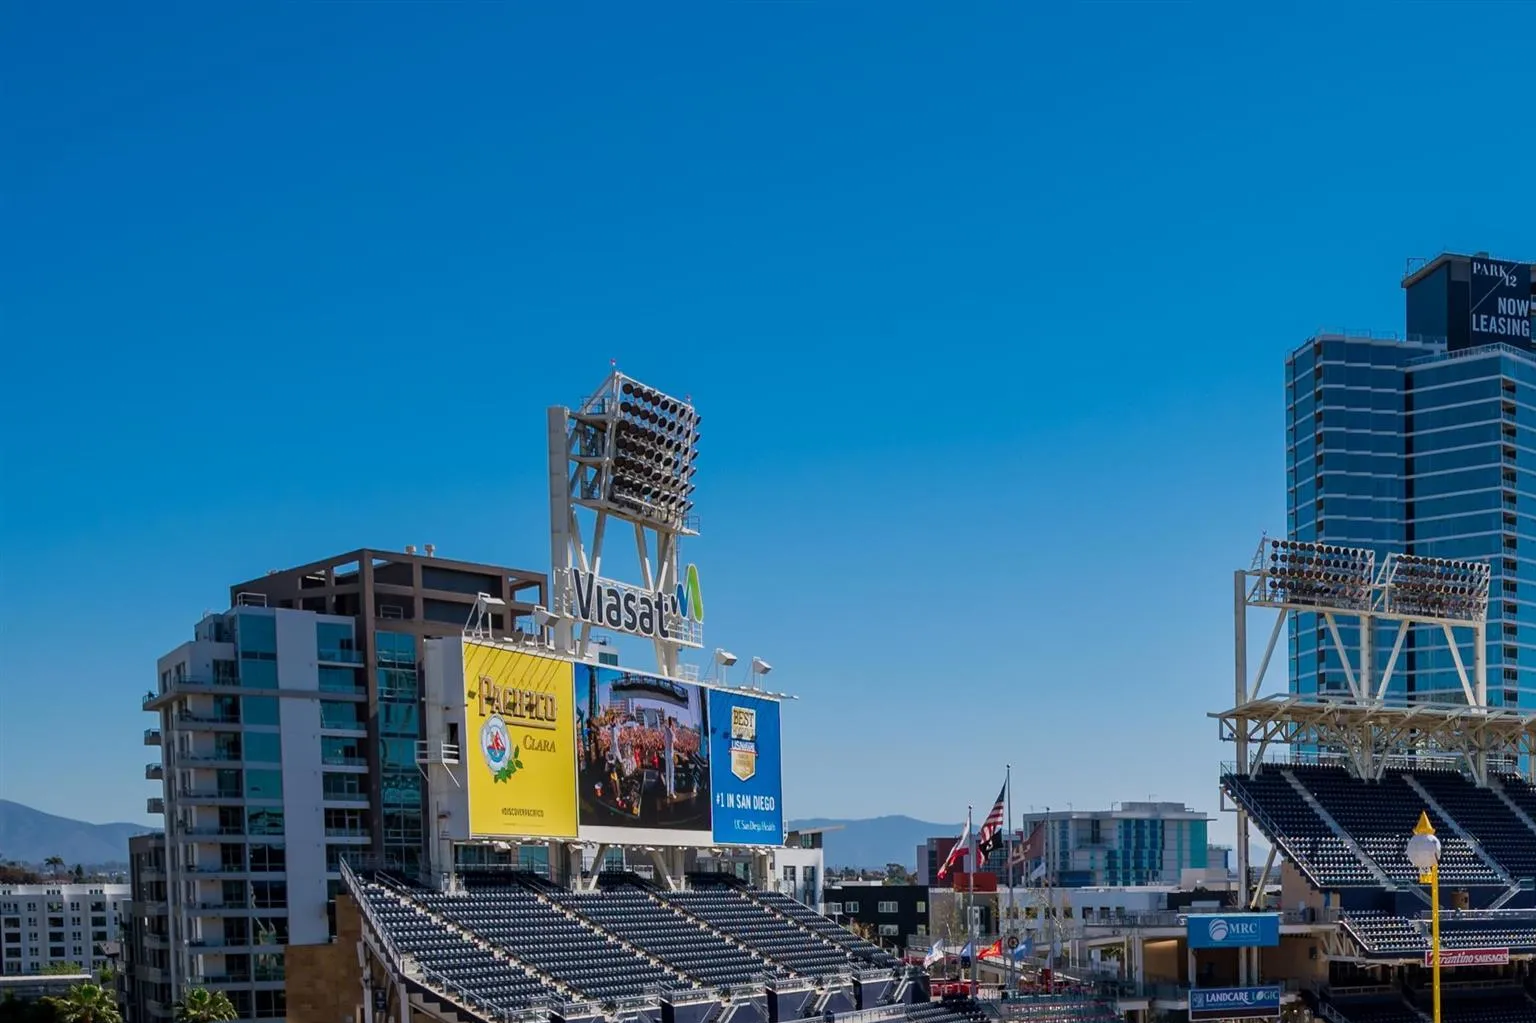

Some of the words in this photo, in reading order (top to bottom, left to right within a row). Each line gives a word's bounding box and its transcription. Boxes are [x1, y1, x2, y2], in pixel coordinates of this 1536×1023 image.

[1473, 262, 1507, 278] PARK
[1505, 275, 1517, 287] 12
[1498, 297, 1529, 317] NOW
[1472, 313, 1530, 337] LEASING
[573, 568, 669, 639] Viasat
[733, 710, 754, 726] BEST
[716, 792, 724, 808] #1
[727, 793, 734, 808] IN
[736, 793, 751, 810] SAN
[753, 795, 775, 811] DIEGO
[1229, 923, 1257, 934] MRC
[1206, 992, 1249, 1003] LANDCARE
[1251, 990, 1278, 1001] LOGIC
